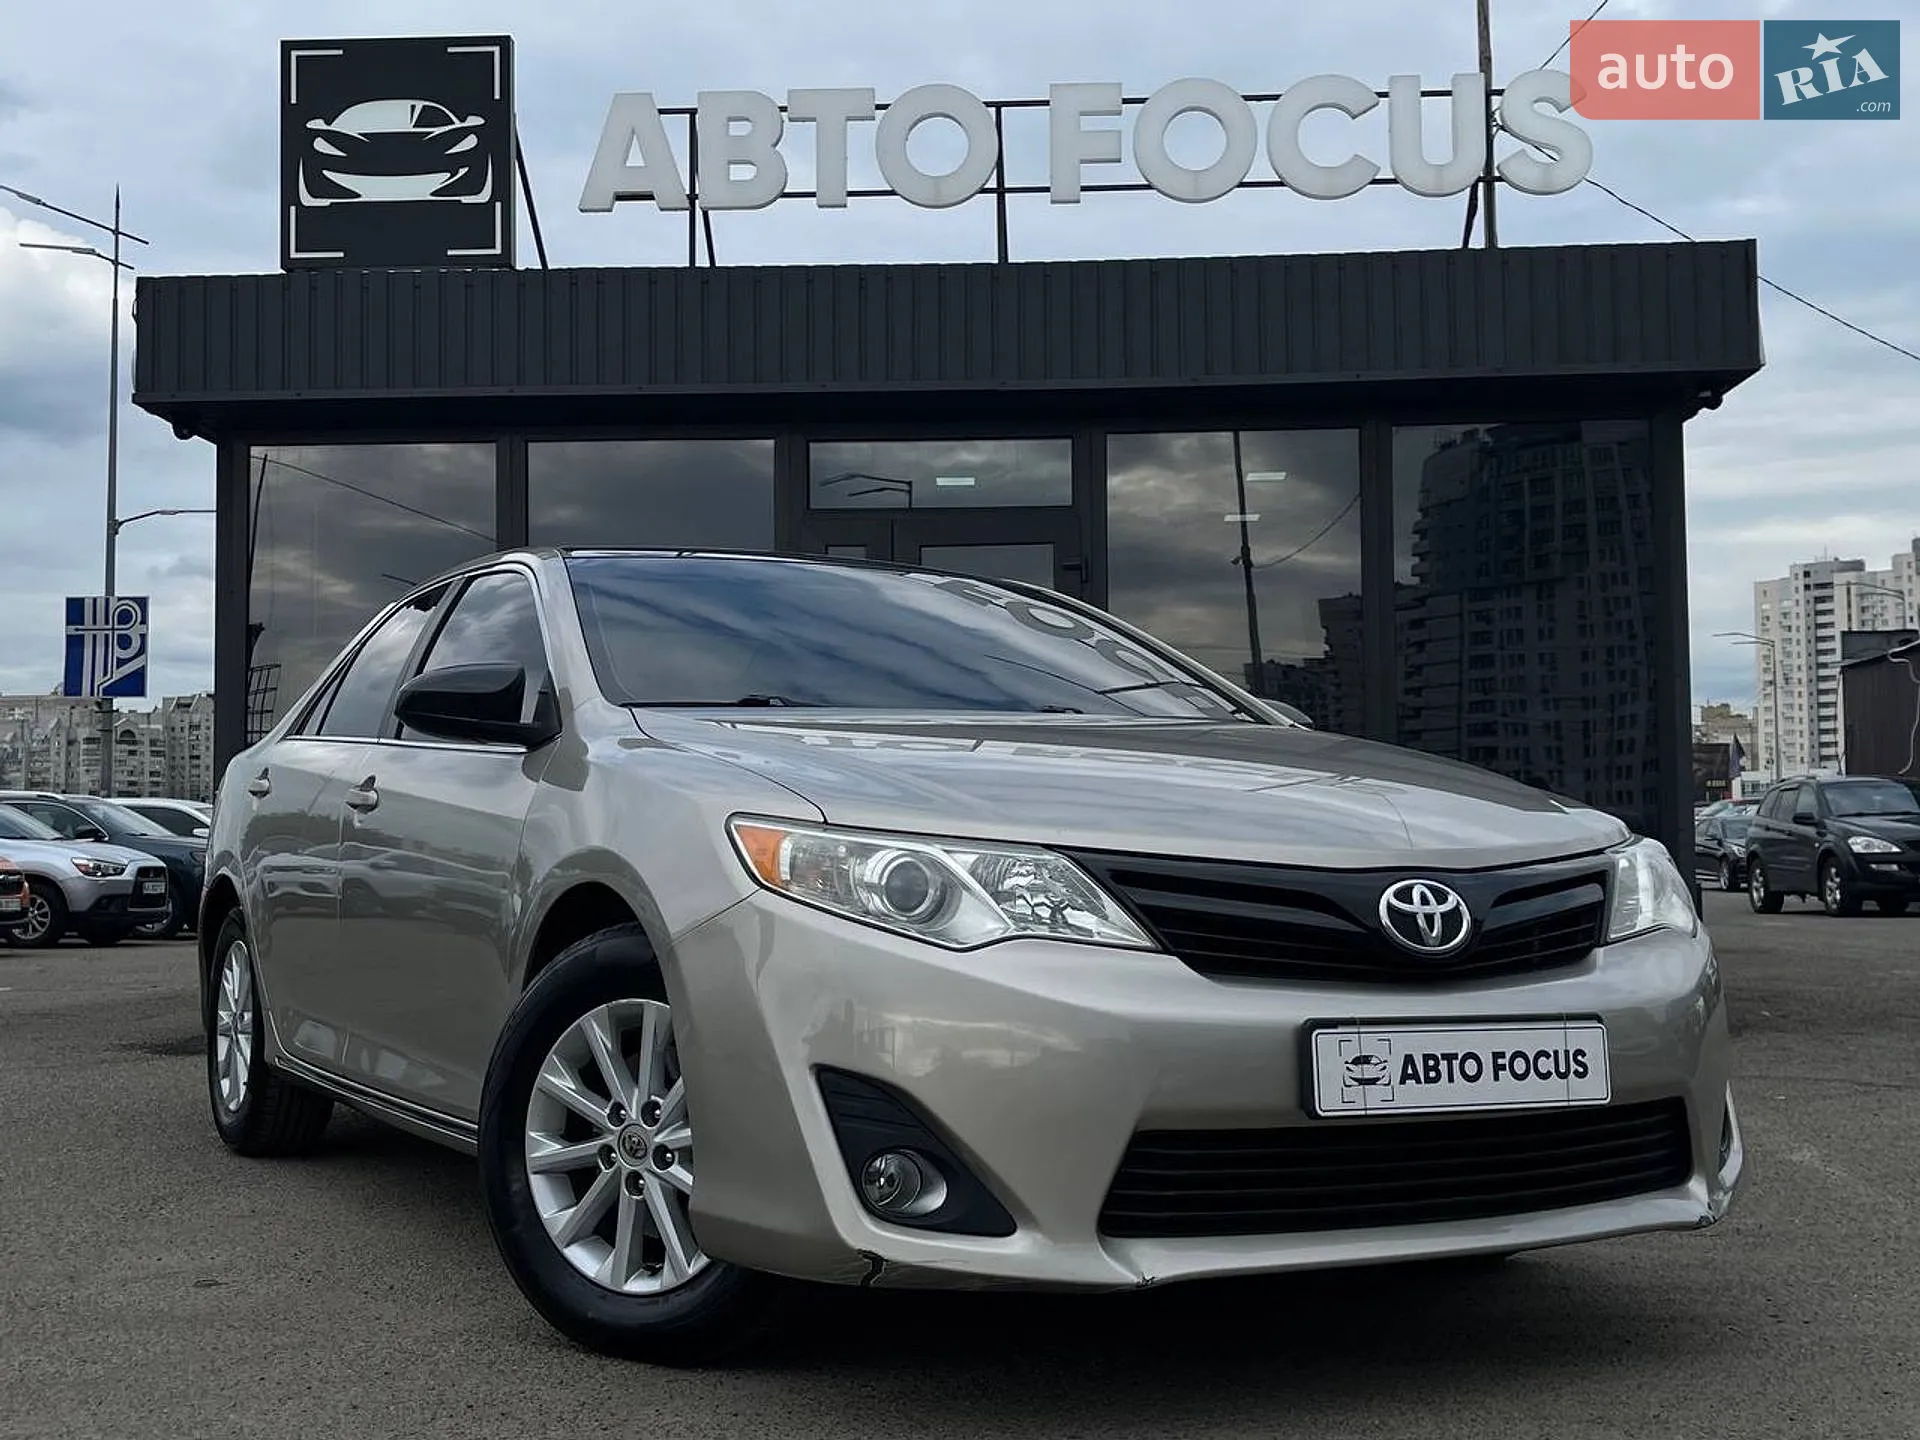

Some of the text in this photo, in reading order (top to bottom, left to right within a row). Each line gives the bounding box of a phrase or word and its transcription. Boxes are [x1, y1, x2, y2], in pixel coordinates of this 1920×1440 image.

[578, 69, 1593, 213] АВТО FOCUS
[1399, 1048, 1590, 1086] АВТО FOCUS
